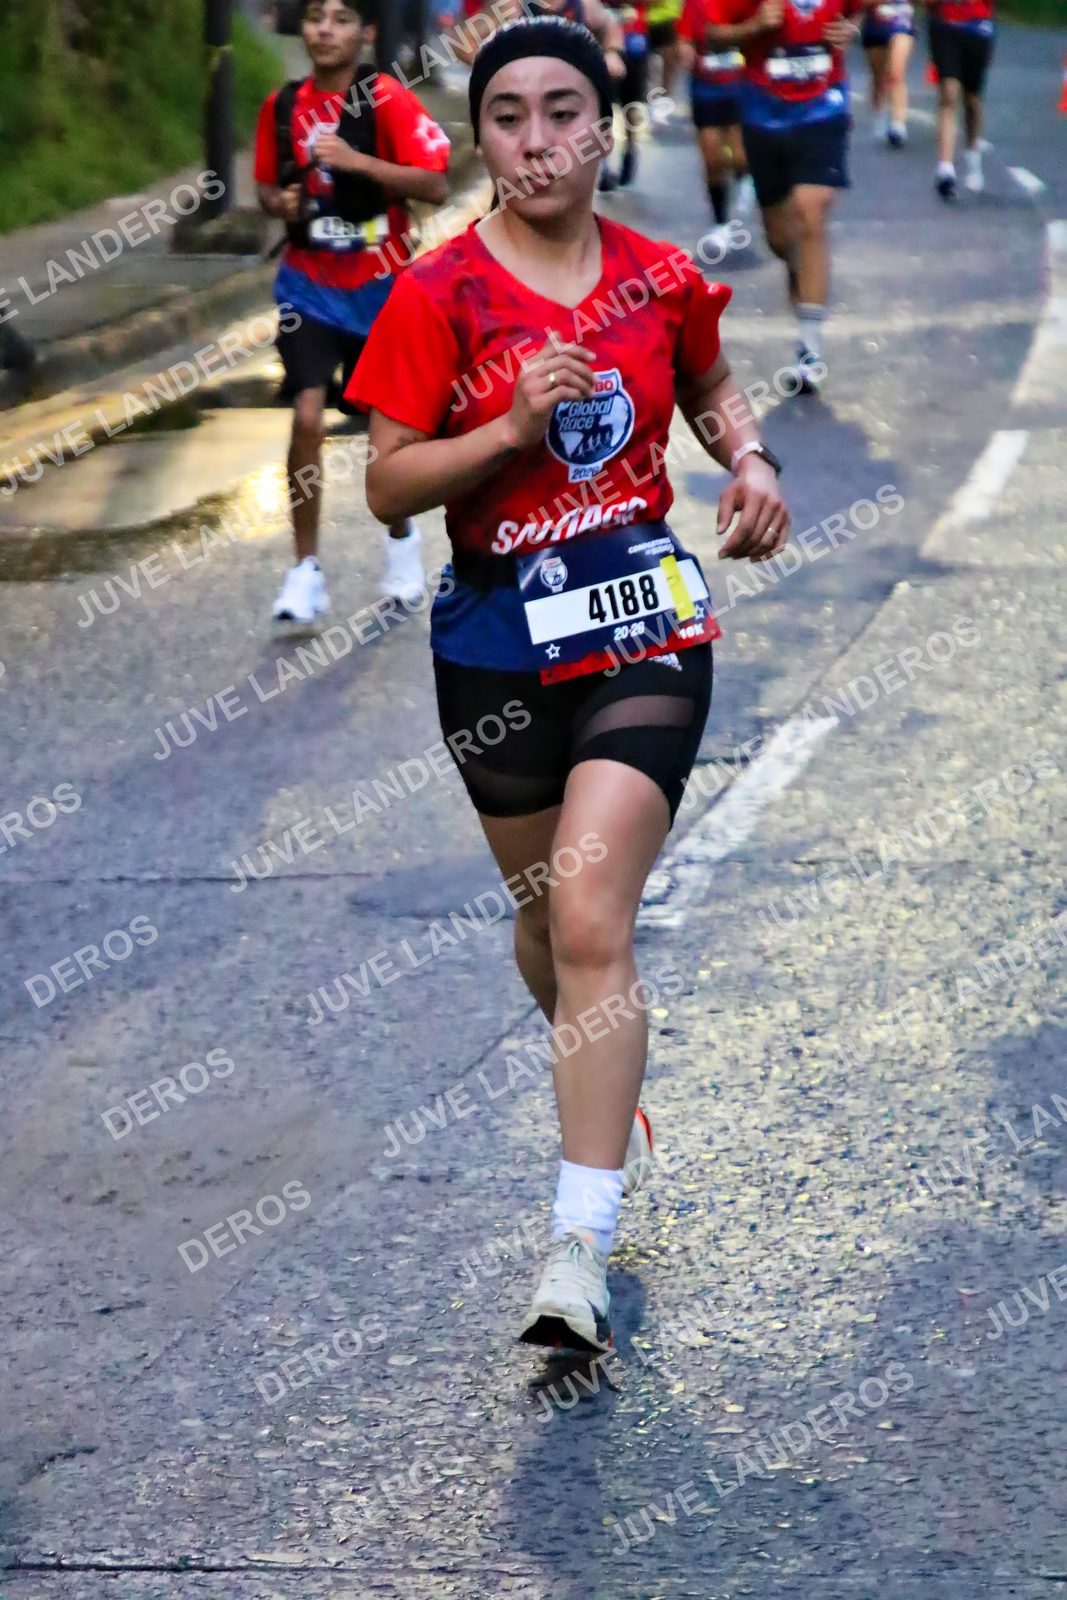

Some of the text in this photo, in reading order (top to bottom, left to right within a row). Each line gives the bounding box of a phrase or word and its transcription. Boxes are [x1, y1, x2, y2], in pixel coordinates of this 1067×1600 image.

[568, 397, 613, 418] Global
[560, 416, 595, 431] Race
[589, 574, 660, 623] 4188
